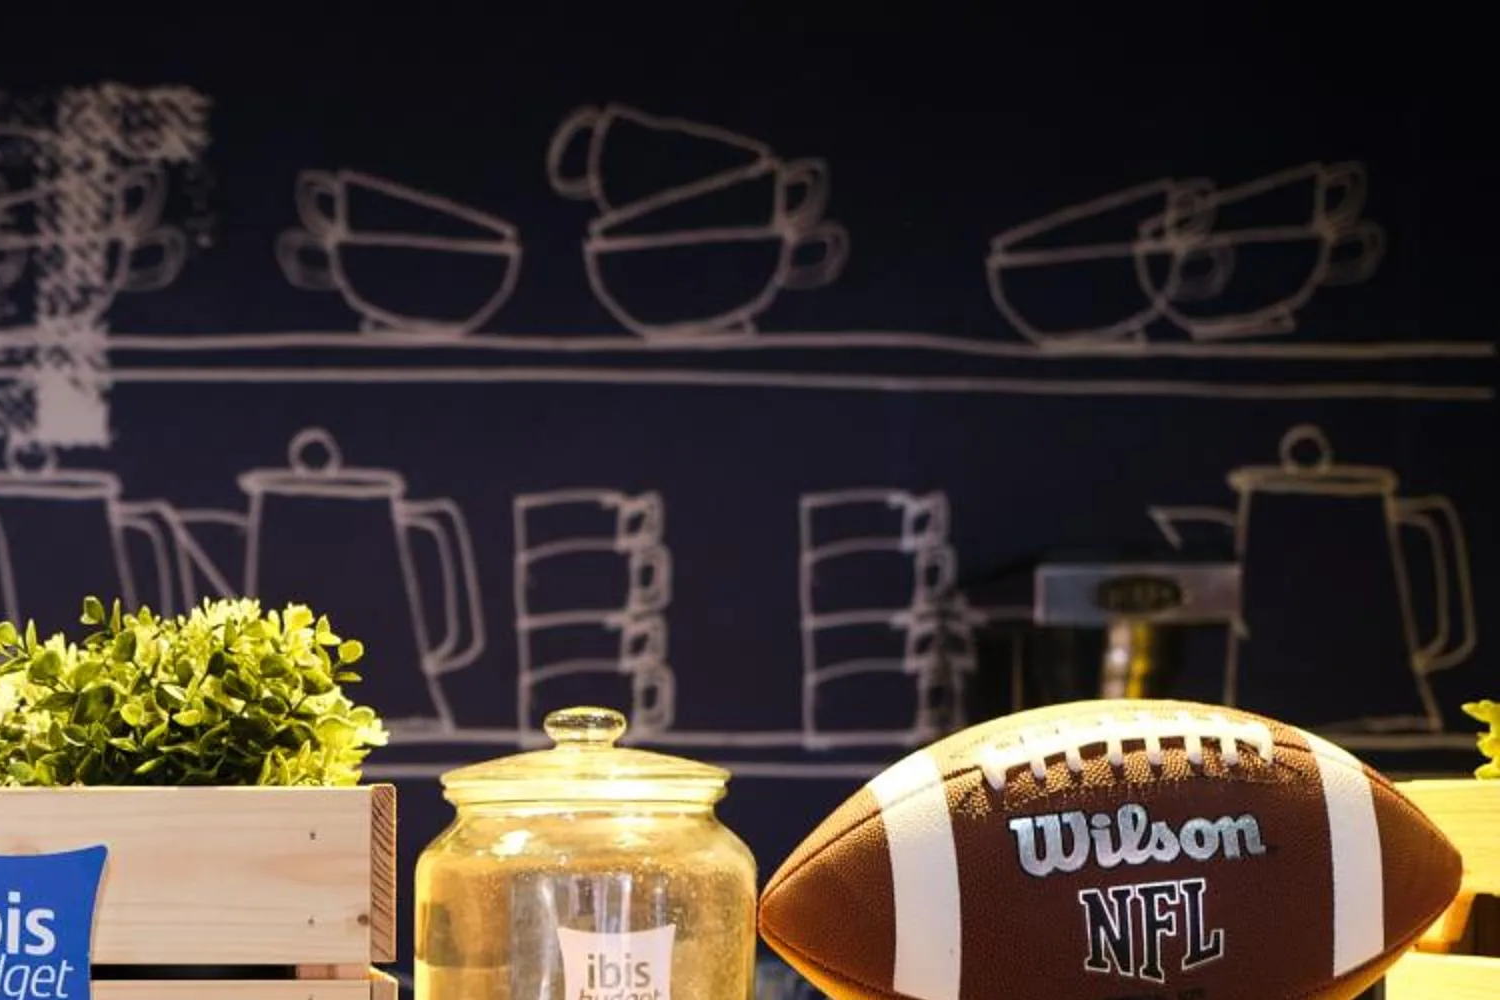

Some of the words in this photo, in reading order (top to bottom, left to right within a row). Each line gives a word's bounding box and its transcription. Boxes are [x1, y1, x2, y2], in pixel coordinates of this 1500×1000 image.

[1008, 802, 1266, 878] Wilson
[1078, 878, 1225, 983] NFL
[586, 953, 651, 989] ibis
